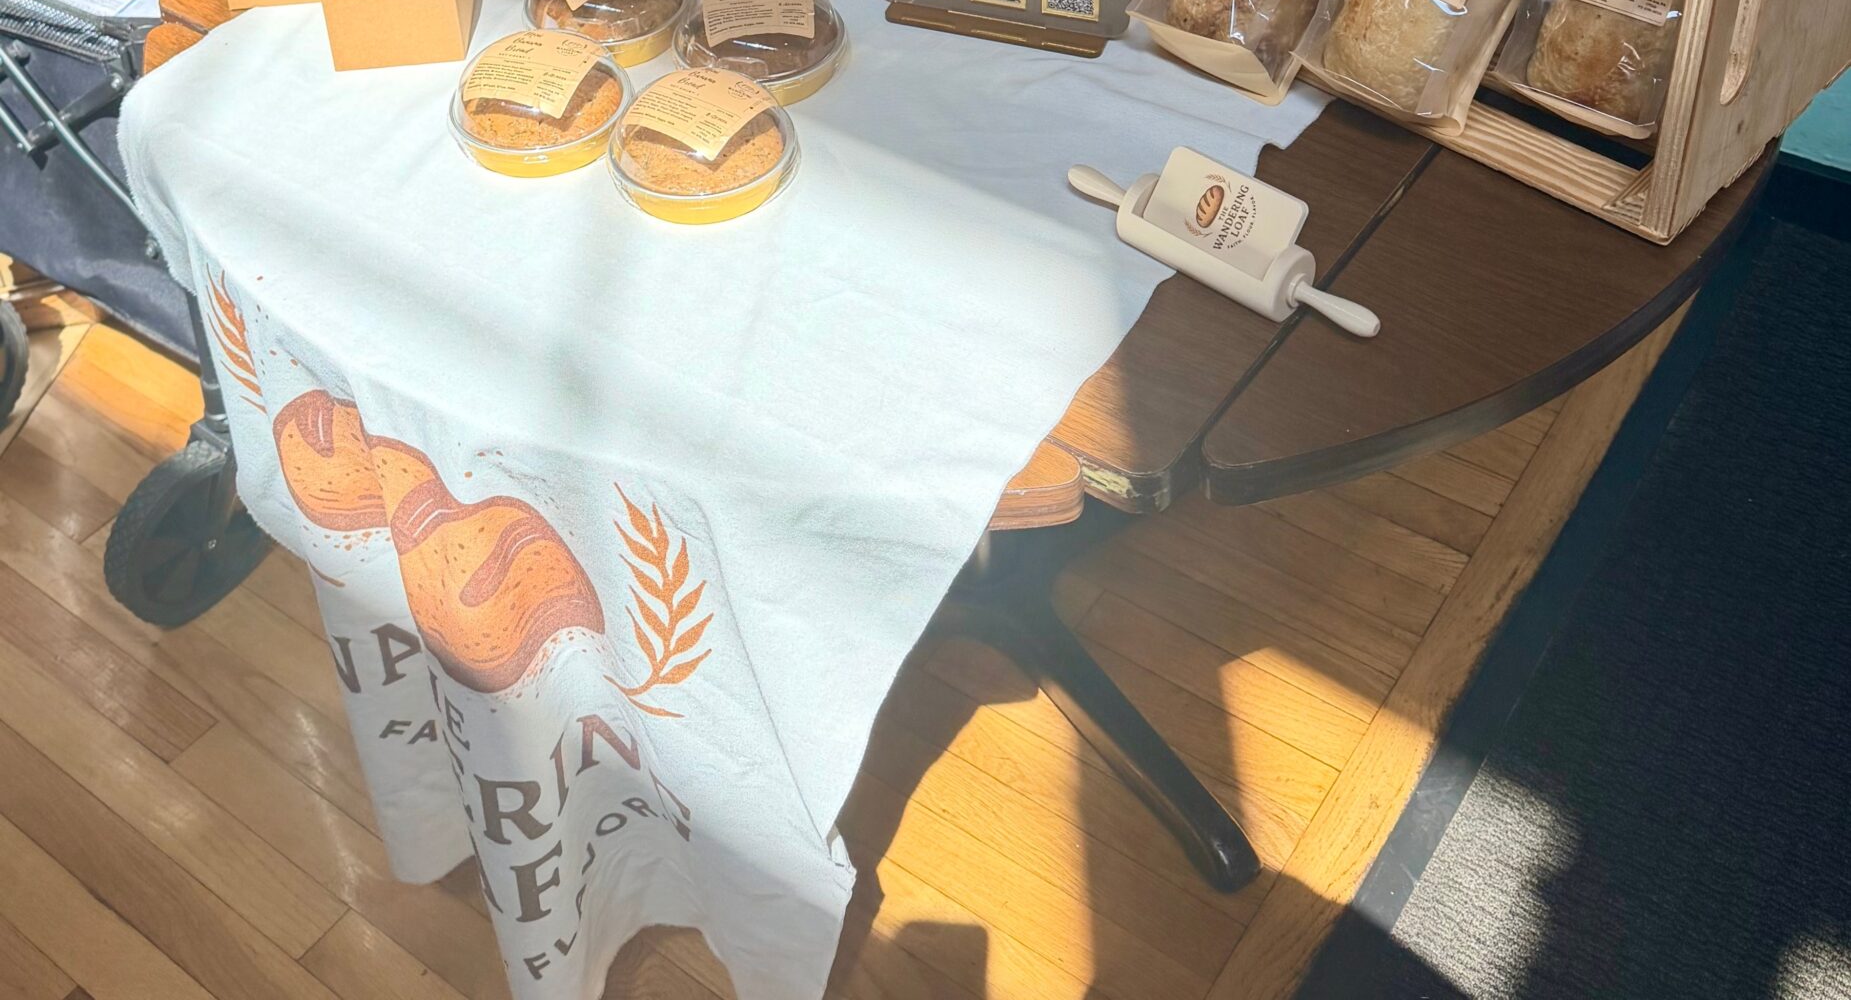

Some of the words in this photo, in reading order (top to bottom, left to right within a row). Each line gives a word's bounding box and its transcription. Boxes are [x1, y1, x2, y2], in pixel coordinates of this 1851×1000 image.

[1212, 184, 1250, 251] WANDERING
[1218, 206, 1229, 221] THE
[1230, 208, 1250, 238] LOAF
